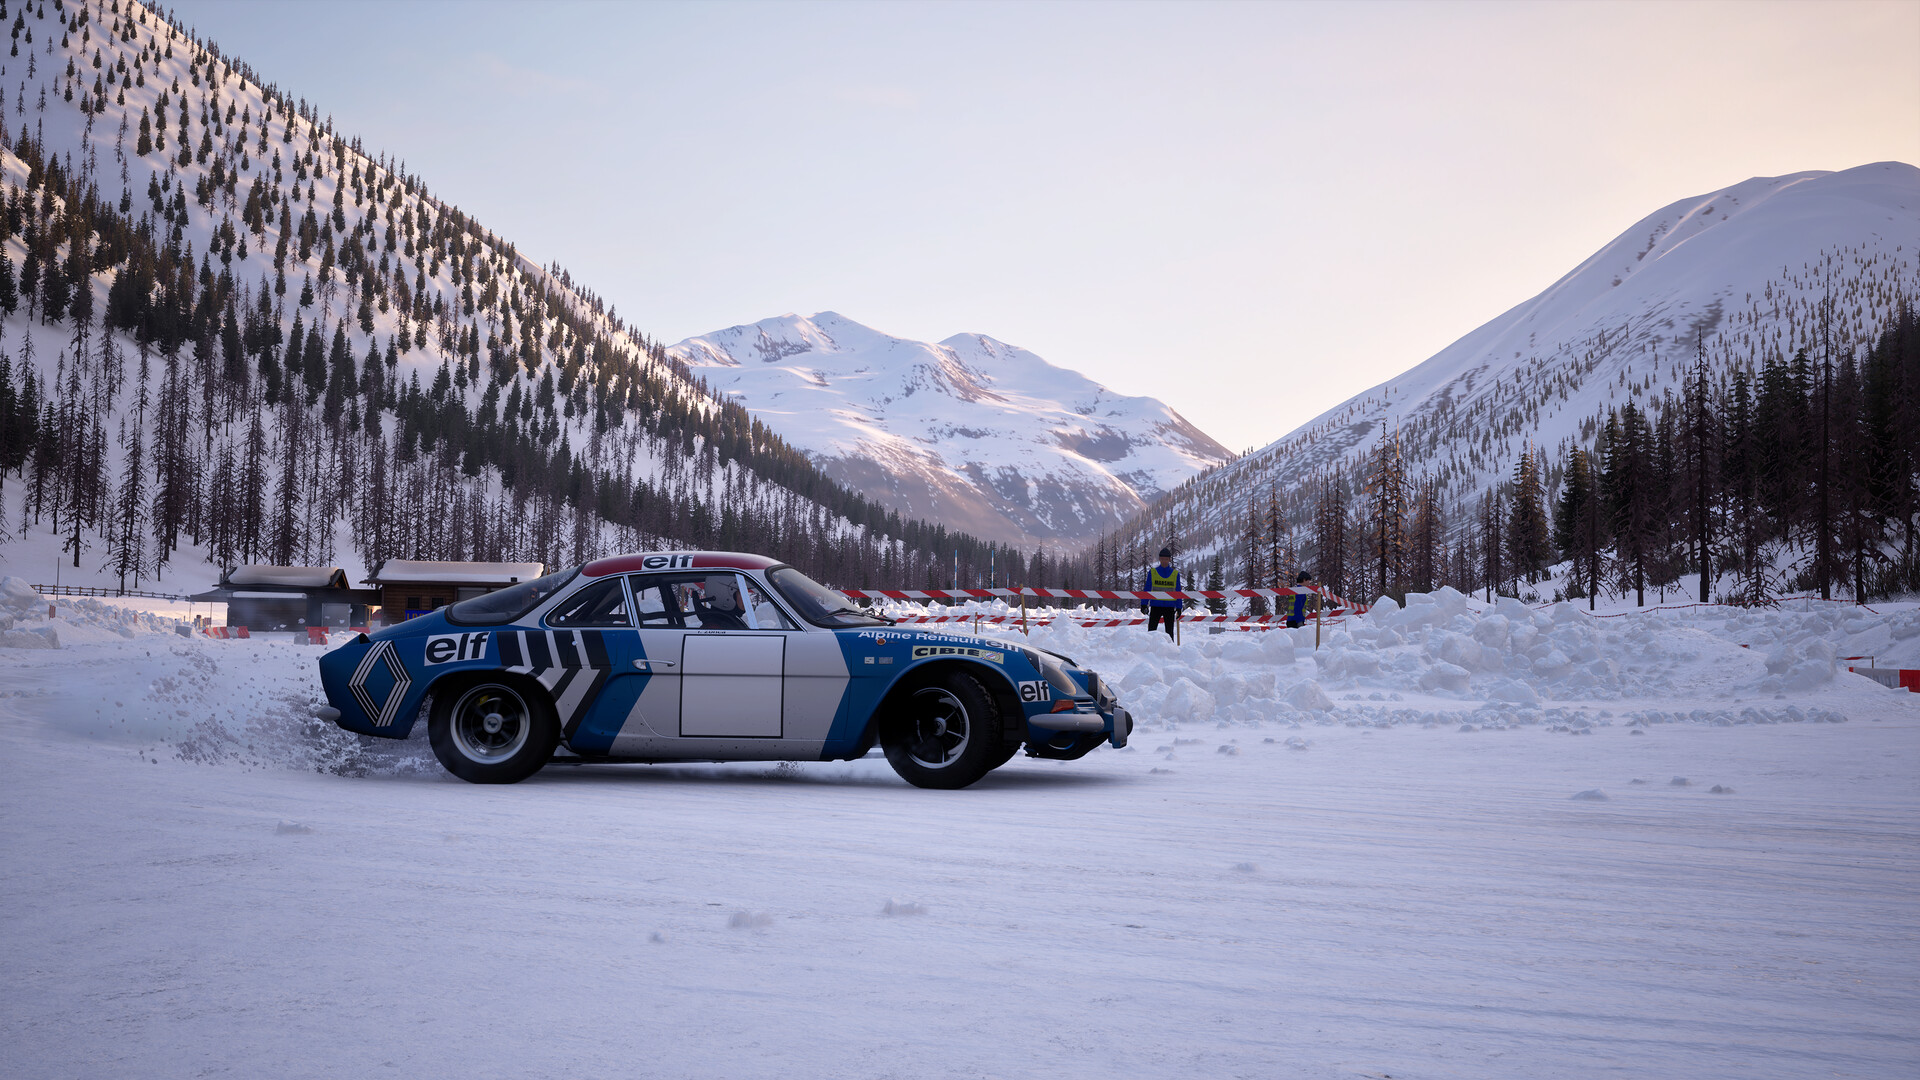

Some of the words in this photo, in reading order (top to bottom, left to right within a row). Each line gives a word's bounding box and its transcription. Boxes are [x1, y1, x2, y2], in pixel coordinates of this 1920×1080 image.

[643, 555, 693, 569] elf
[858, 631, 912, 641] Alpine
[916, 633, 980, 645] Renault
[426, 631, 490, 663] elf
[914, 647, 980, 657] CIBIE
[987, 640, 1016, 651] elf
[1020, 680, 1048, 702] elf
